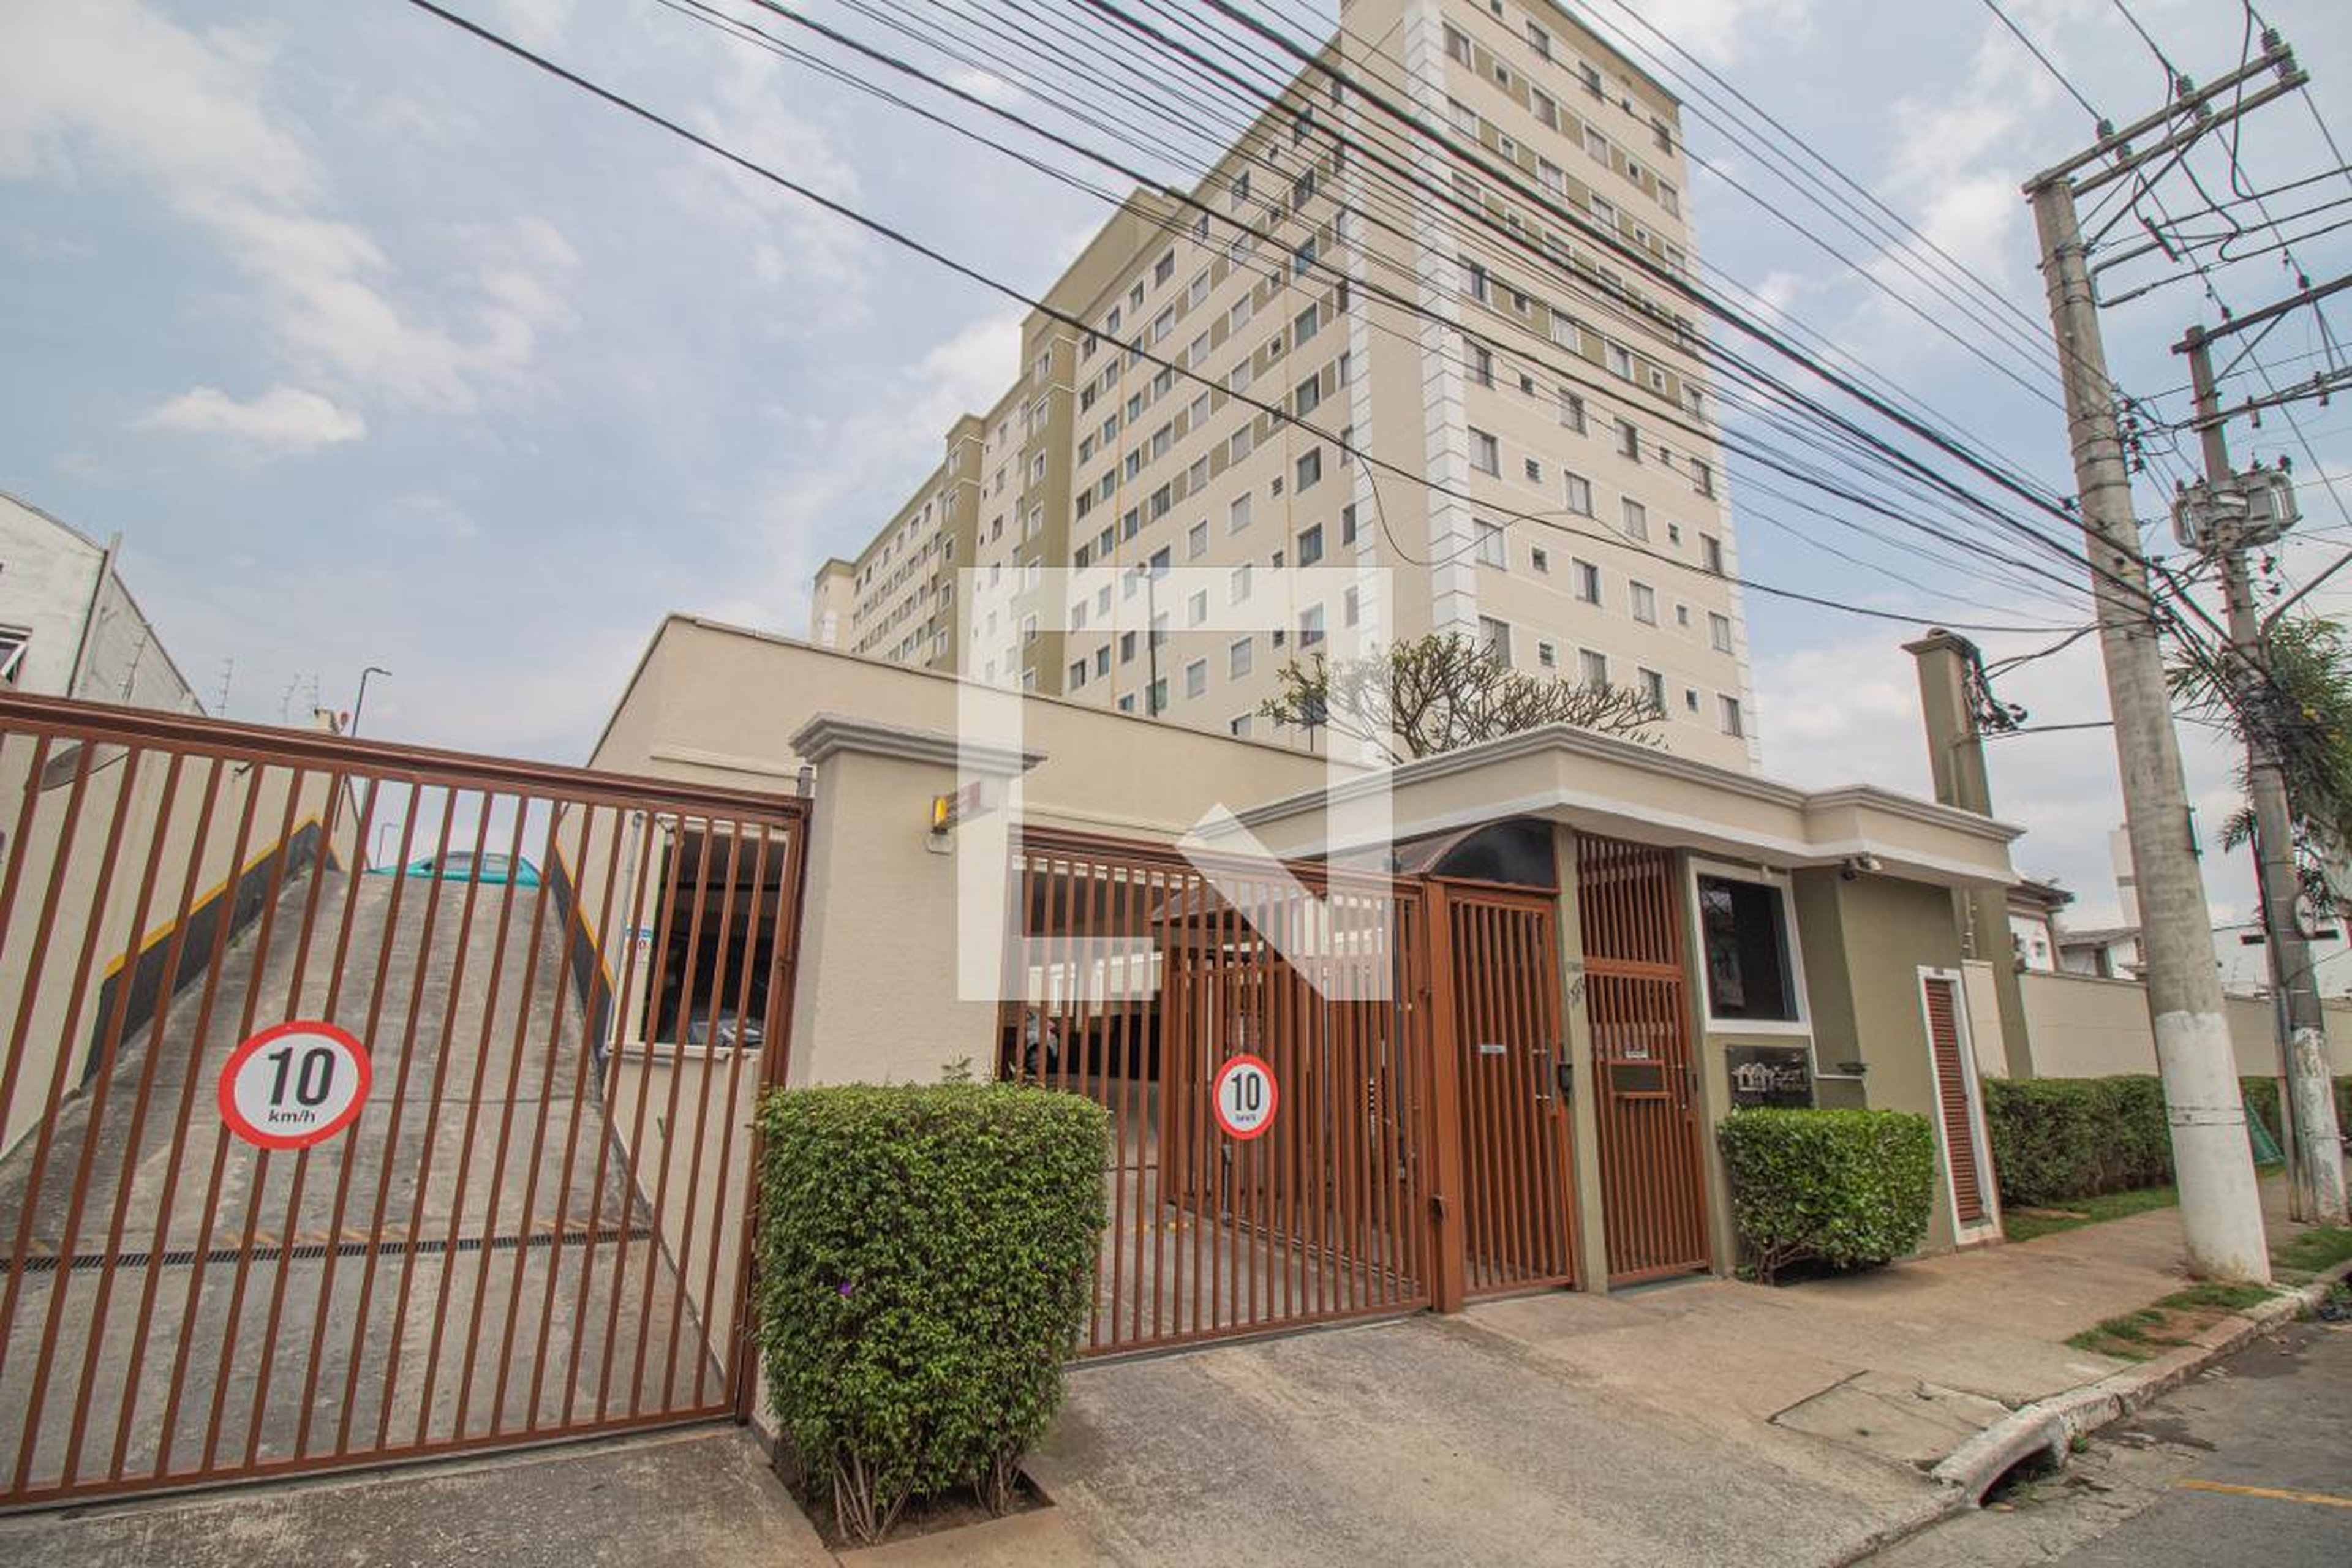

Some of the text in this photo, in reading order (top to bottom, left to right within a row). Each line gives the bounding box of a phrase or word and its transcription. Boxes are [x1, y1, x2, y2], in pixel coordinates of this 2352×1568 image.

[268, 1047, 335, 1106] 10
[1232, 1072, 1260, 1110] 10
[269, 1110, 315, 1122] km/h
